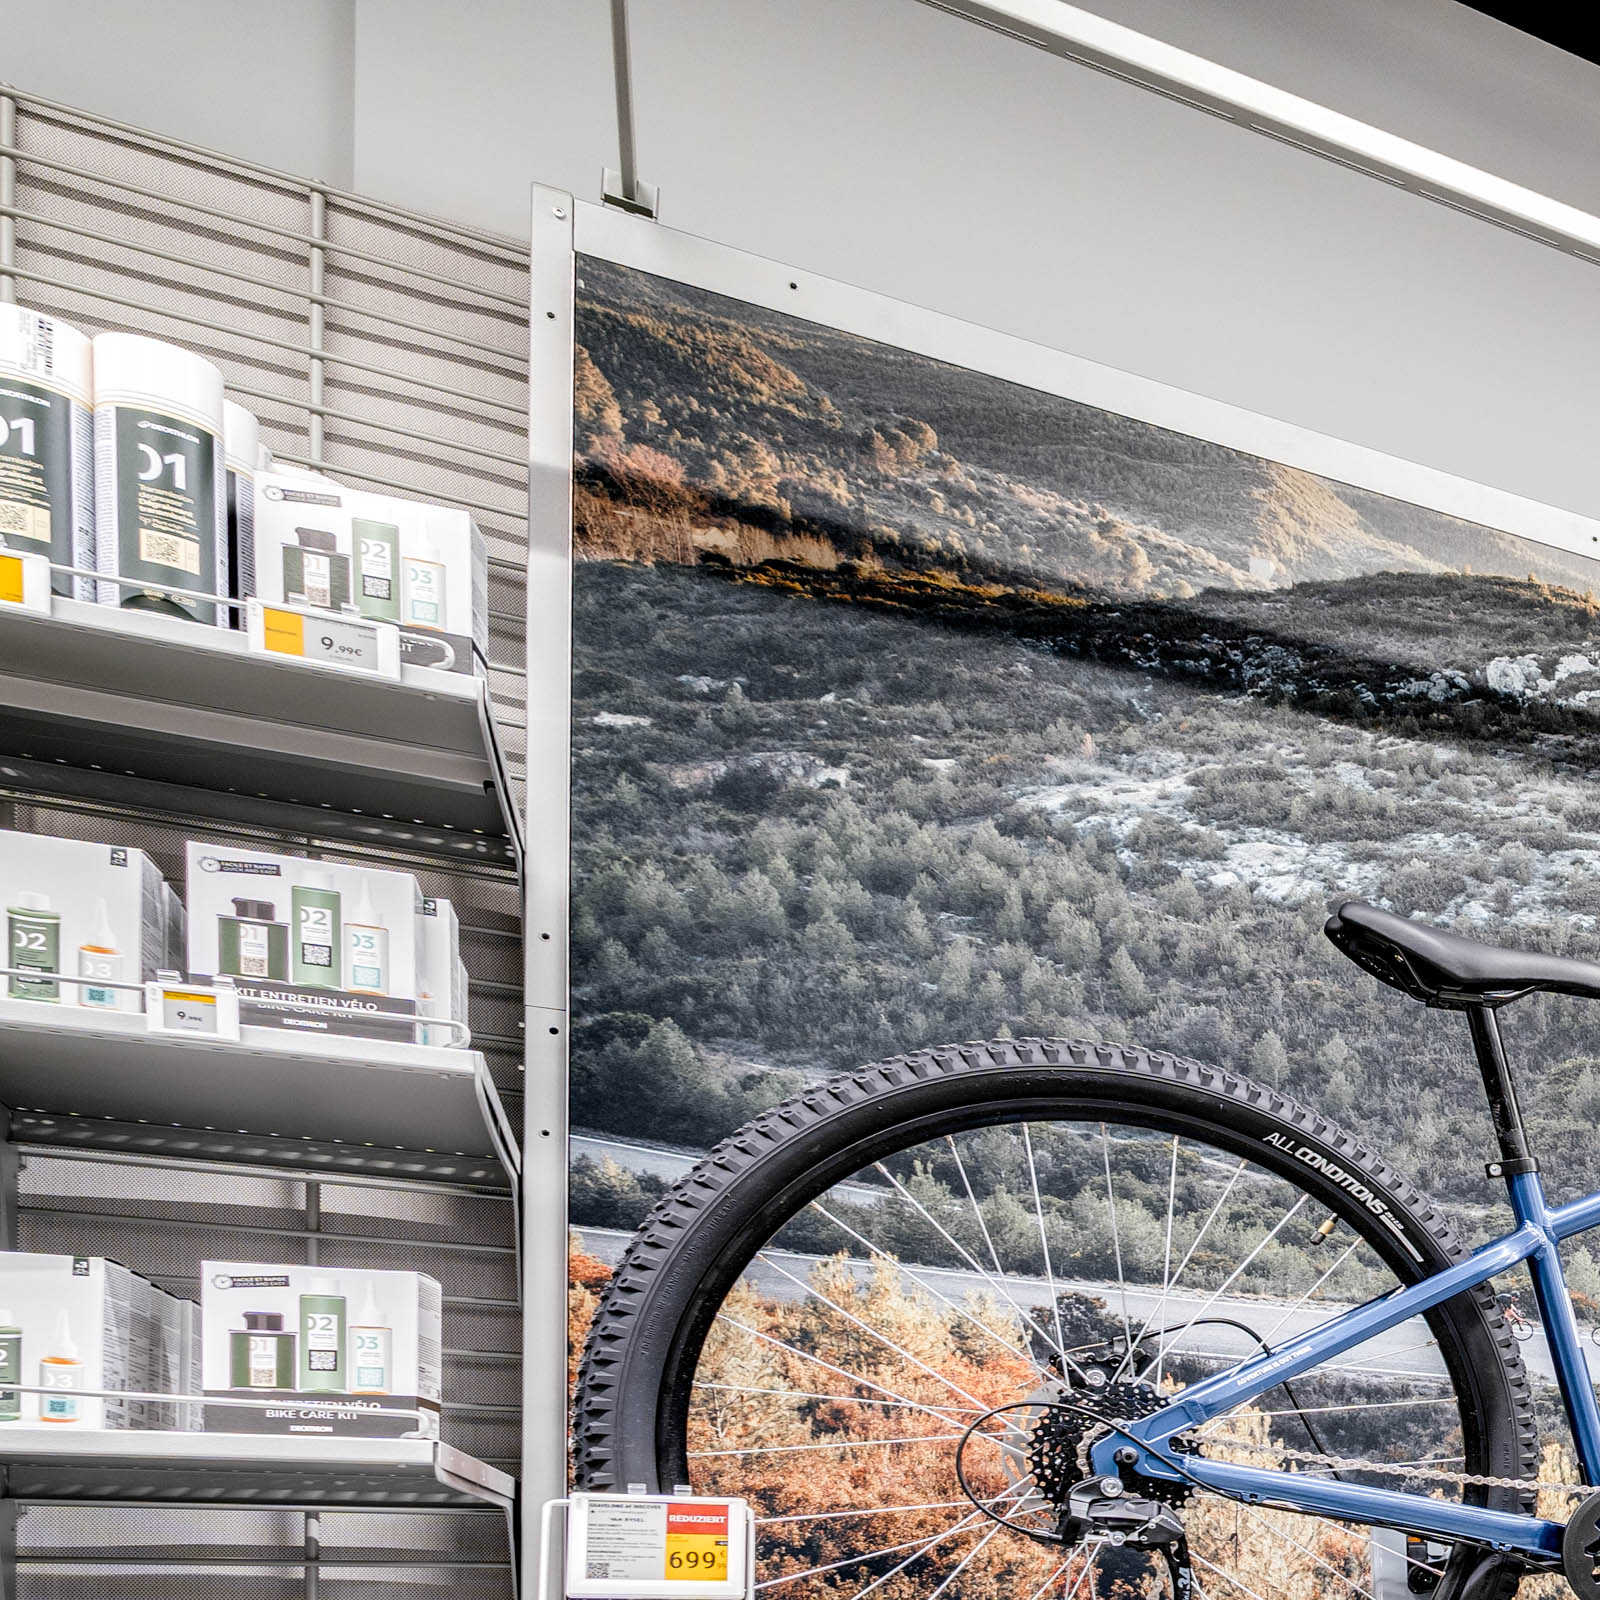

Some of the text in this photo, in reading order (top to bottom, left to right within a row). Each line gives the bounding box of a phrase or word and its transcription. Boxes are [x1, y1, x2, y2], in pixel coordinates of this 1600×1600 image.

[260, 989, 335, 1011] ENTRETIEN
[338, 994, 379, 1013] VÉLO
[1262, 1132, 1389, 1215] ALL CONDITIONS
[266, 1409, 297, 1420] BIKE
[300, 1409, 336, 1421] CARE
[669, 1514, 727, 1523] REDUZIERT
[670, 1551, 716, 1569] 699
